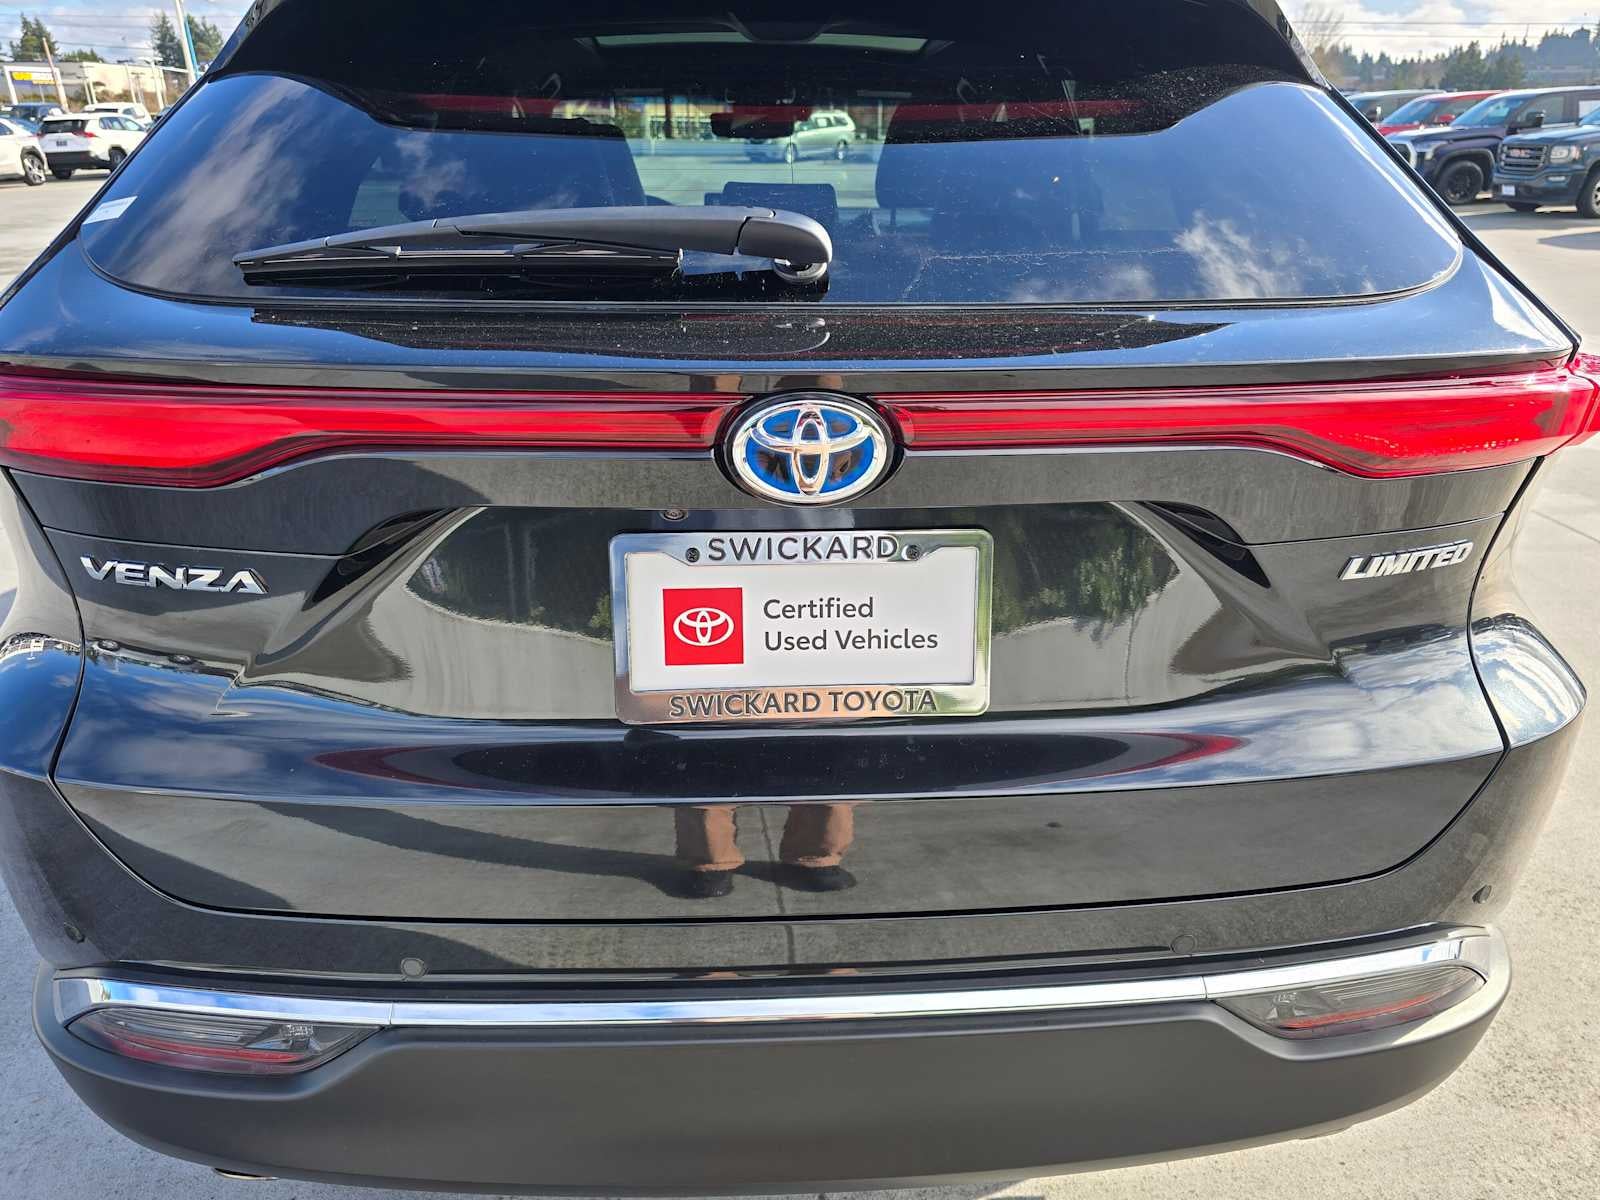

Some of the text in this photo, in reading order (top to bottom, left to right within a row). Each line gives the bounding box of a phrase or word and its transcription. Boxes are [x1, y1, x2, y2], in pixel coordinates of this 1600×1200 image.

[707, 535, 898, 561] SWICKARD
[1338, 540, 1474, 581] LIMITED
[79, 554, 269, 594] VENZA
[763, 597, 874, 619] Certified
[764, 629, 939, 651] Used Vehicles
[669, 688, 938, 717] SWICKARD TOYOTA
